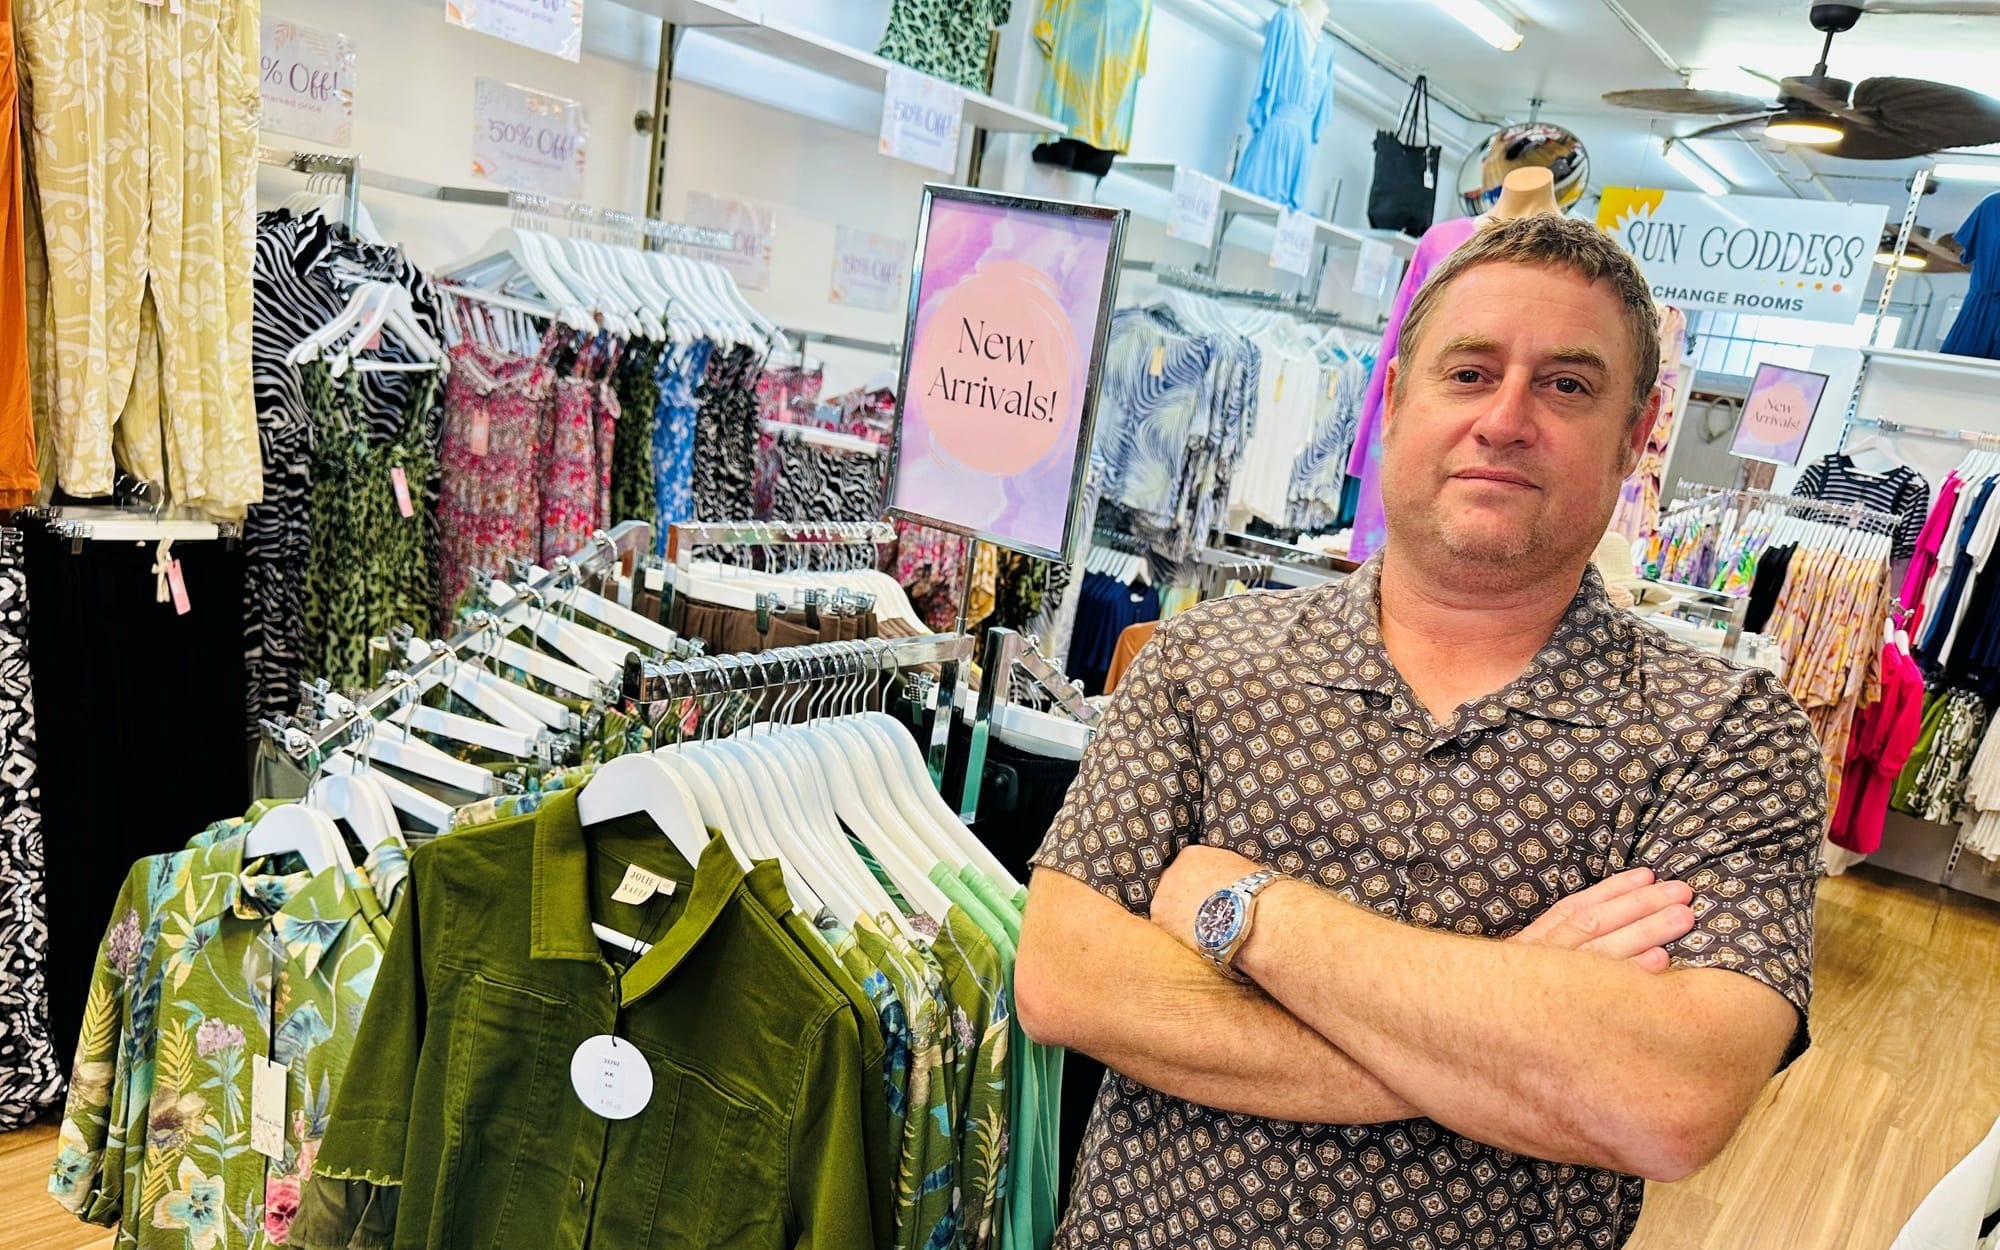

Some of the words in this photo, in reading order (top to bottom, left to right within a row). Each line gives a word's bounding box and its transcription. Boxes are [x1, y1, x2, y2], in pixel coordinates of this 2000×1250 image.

[289, 62, 338, 102] Off!
[488, 118, 534, 149] 50%
[1626, 219, 1687, 265] SUN
[1699, 226, 1865, 279] GODDESS
[1652, 284, 1729, 304] CHANGE
[1733, 292, 1804, 312] ROOMS
[957, 316, 1035, 366] New
[927, 366, 1058, 423] Arrivals!
[1764, 398, 1794, 413] New
[1751, 411, 1801, 429] Arrivals!
[630, 872, 655, 886] JOLIE
